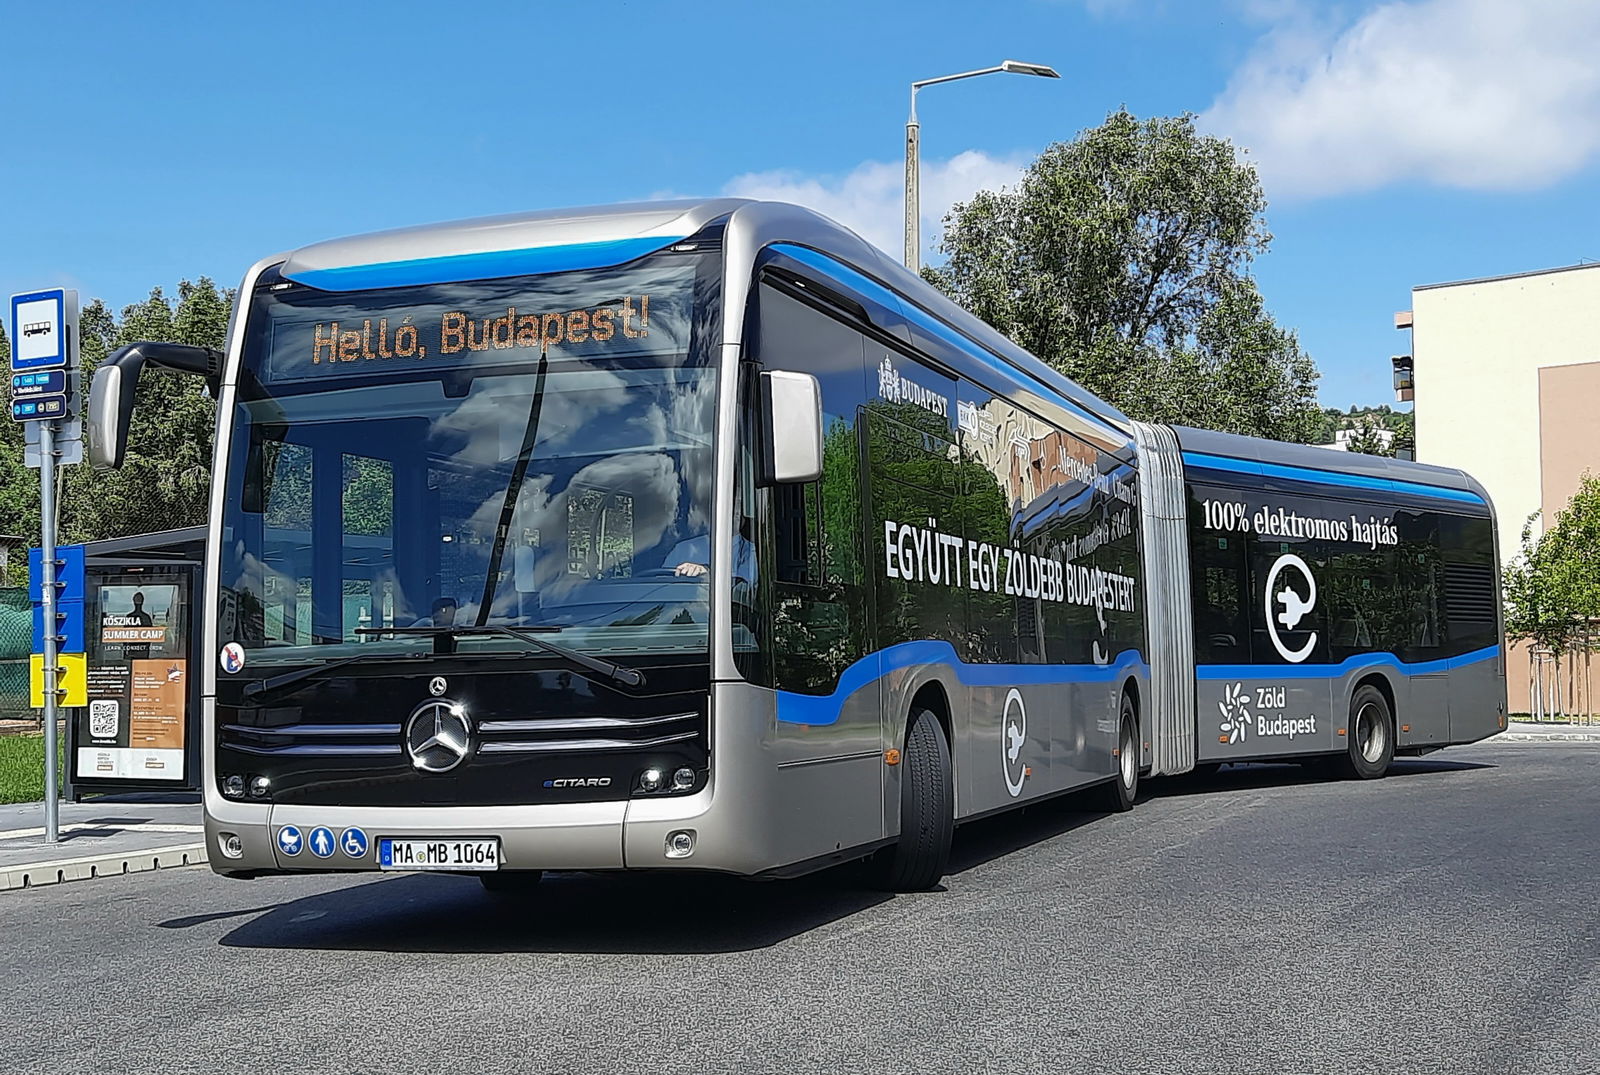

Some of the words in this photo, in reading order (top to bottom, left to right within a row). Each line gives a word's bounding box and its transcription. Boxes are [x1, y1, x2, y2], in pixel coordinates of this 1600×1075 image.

[312, 315, 427, 364] Helló,
[440, 295, 649, 354] Budapest!
[901, 377, 948, 417] BUDAPEST
[1202, 499, 1249, 532] 100%
[1253, 505, 1348, 541] elektromos
[1350, 515, 1398, 550] hajtás
[885, 517, 963, 587] EGYÜTT
[968, 540, 999, 593] EGY
[1004, 539, 1064, 602] ZÖLDEBB
[1066, 565, 1134, 612] BUDAPESTÉRT
[103, 630, 139, 640] SUMMER
[140, 630, 164, 640] CAMP
[1256, 687, 1286, 708] Zöld
[1257, 713, 1316, 740] Budapest
[543, 777, 612, 788] eCITARO
[393, 843, 414, 864] MA
[427, 843, 448, 864] MB
[453, 843, 495, 864] 1064
